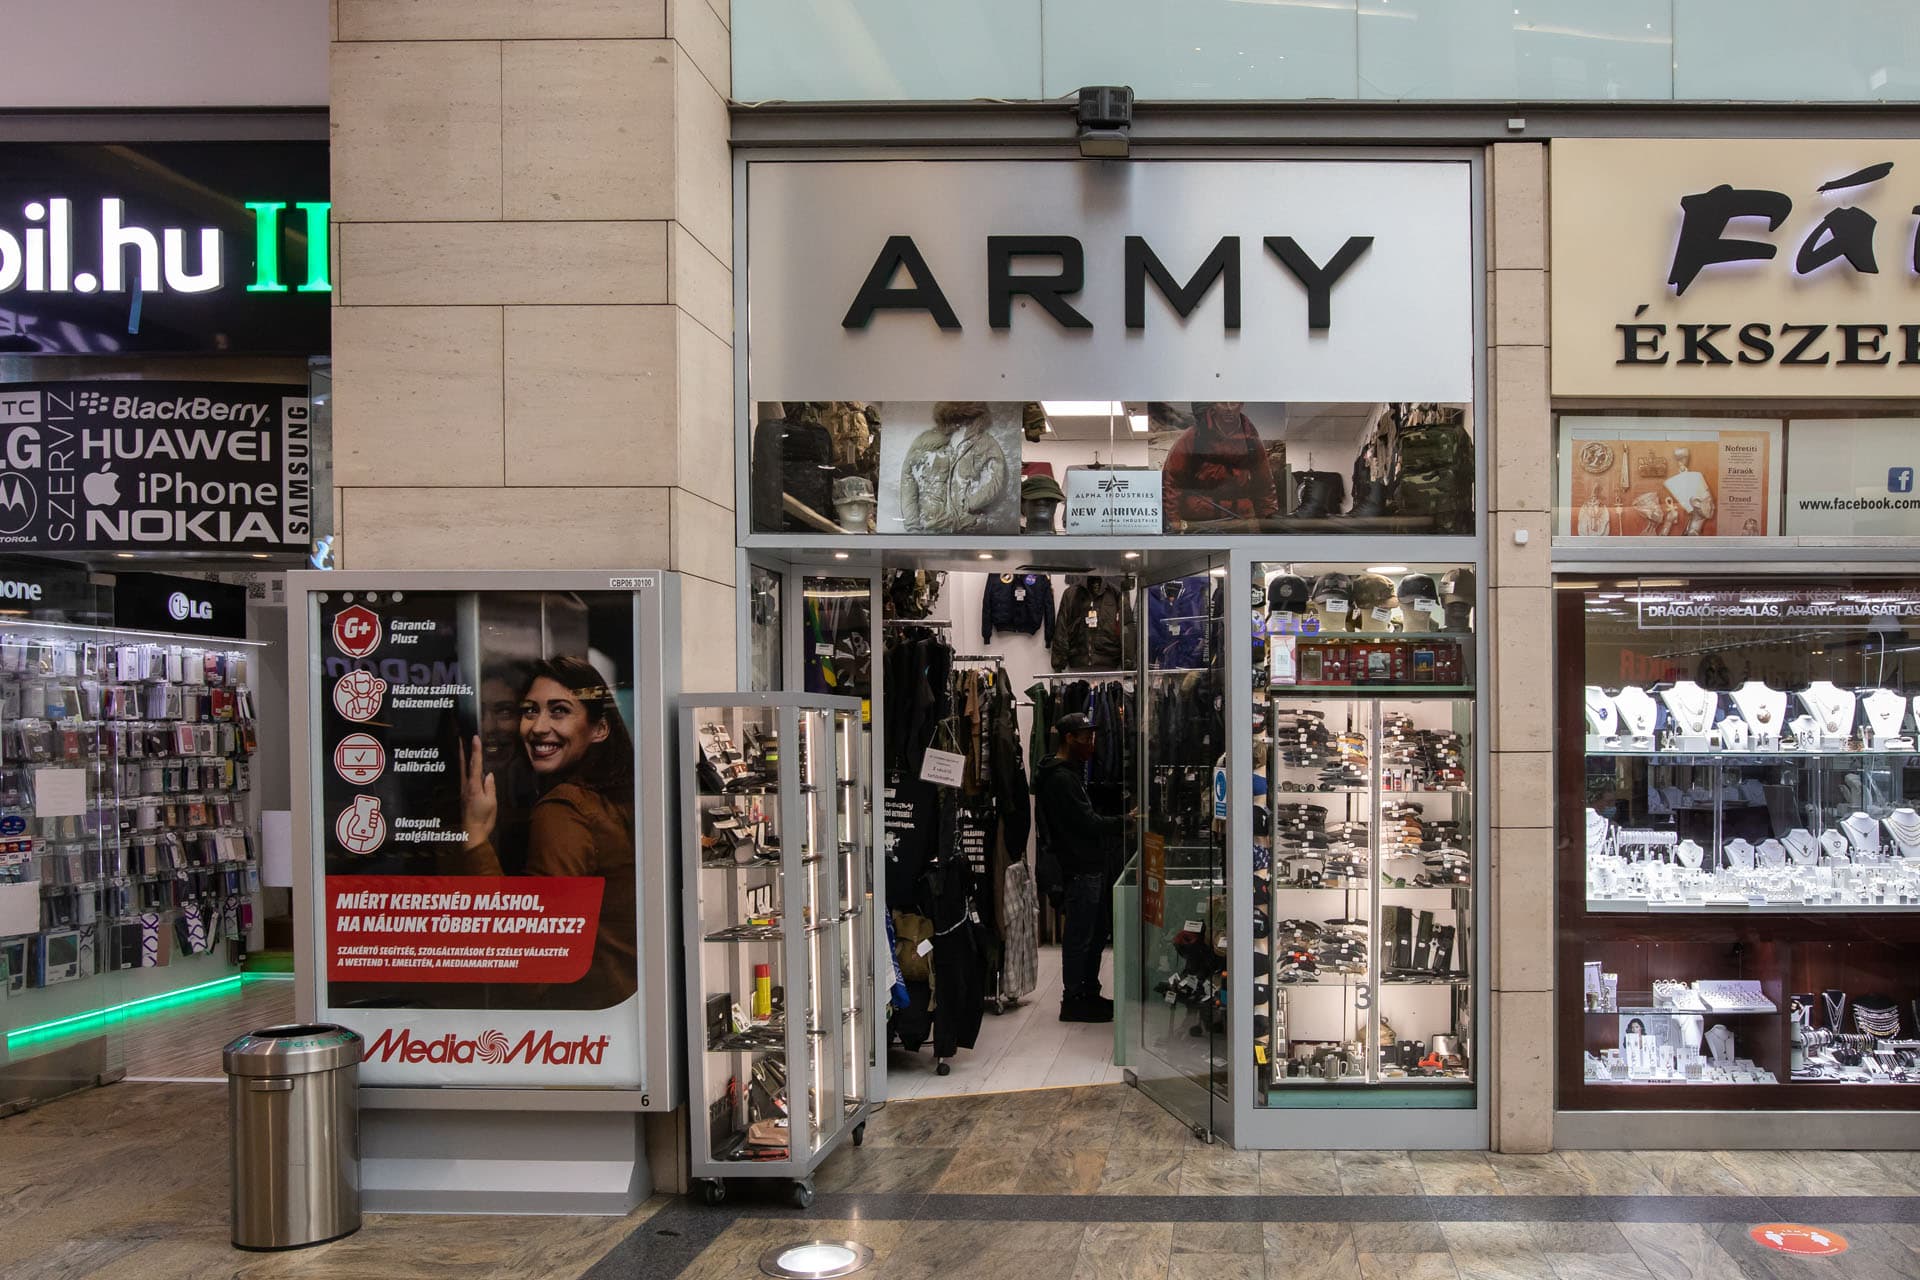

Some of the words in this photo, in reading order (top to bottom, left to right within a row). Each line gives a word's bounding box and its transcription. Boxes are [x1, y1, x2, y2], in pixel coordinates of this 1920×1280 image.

[1667, 161, 1920, 296] Fá
[841, 235, 1376, 329] ARMY
[113, 396, 268, 428] BlackBerry
[82, 428, 271, 462] HUAWEI
[47, 390, 75, 542] SZERVIZ
[287, 406, 309, 535] SAMSUNG
[138, 471, 278, 506] iPhone
[1071, 507, 1097, 517] NEW
[1102, 507, 1159, 517] ARRIVALS
[86, 510, 280, 543] NOKIA
[611, 578, 633, 587] CBP06
[191, 600, 213, 619] LG
[344, 617, 371, 639] G+
[390, 619, 436, 631] Garancia
[390, 634, 418, 644] Plusz
[391, 684, 429, 695] Házhoz
[430, 684, 474, 696] szállítás,
[393, 748, 439, 759] Televízió
[393, 761, 446, 772] kalibráció
[395, 817, 441, 829] Okospult
[394, 831, 469, 844] szolgáltatások
[336, 890, 389, 909] MIÉRT
[389, 891, 471, 911] KERESNÉD
[473, 892, 545, 913] MÁSHOL,
[336, 915, 360, 932] HA
[362, 913, 428, 932] NÁLUNK
[431, 914, 492, 933] TÖBBET
[492, 917, 586, 934] KAPHATSZ?
[337, 945, 379, 956] SZAKÉRTŐ
[417, 946, 485, 957] SZOLGÁLTATÁSOK
[485, 946, 495, 956] ÉS
[495, 946, 523, 957] SZÉLES
[523, 946, 570, 957] VÁLASZTÉK
[337, 958, 344, 967] A
[344, 958, 383, 967] WESTEND
[384, 958, 391, 967] 1.
[391, 956, 434, 968] EMELETÉN,
[435, 959, 442, 967] A
[442, 959, 519, 968] MEDIAMARKTBAN!
[1355, 984, 1371, 1009] 3
[362, 1028, 478, 1064] Media
[502, 1030, 609, 1065] Markt
[641, 1094, 650, 1107] 6
